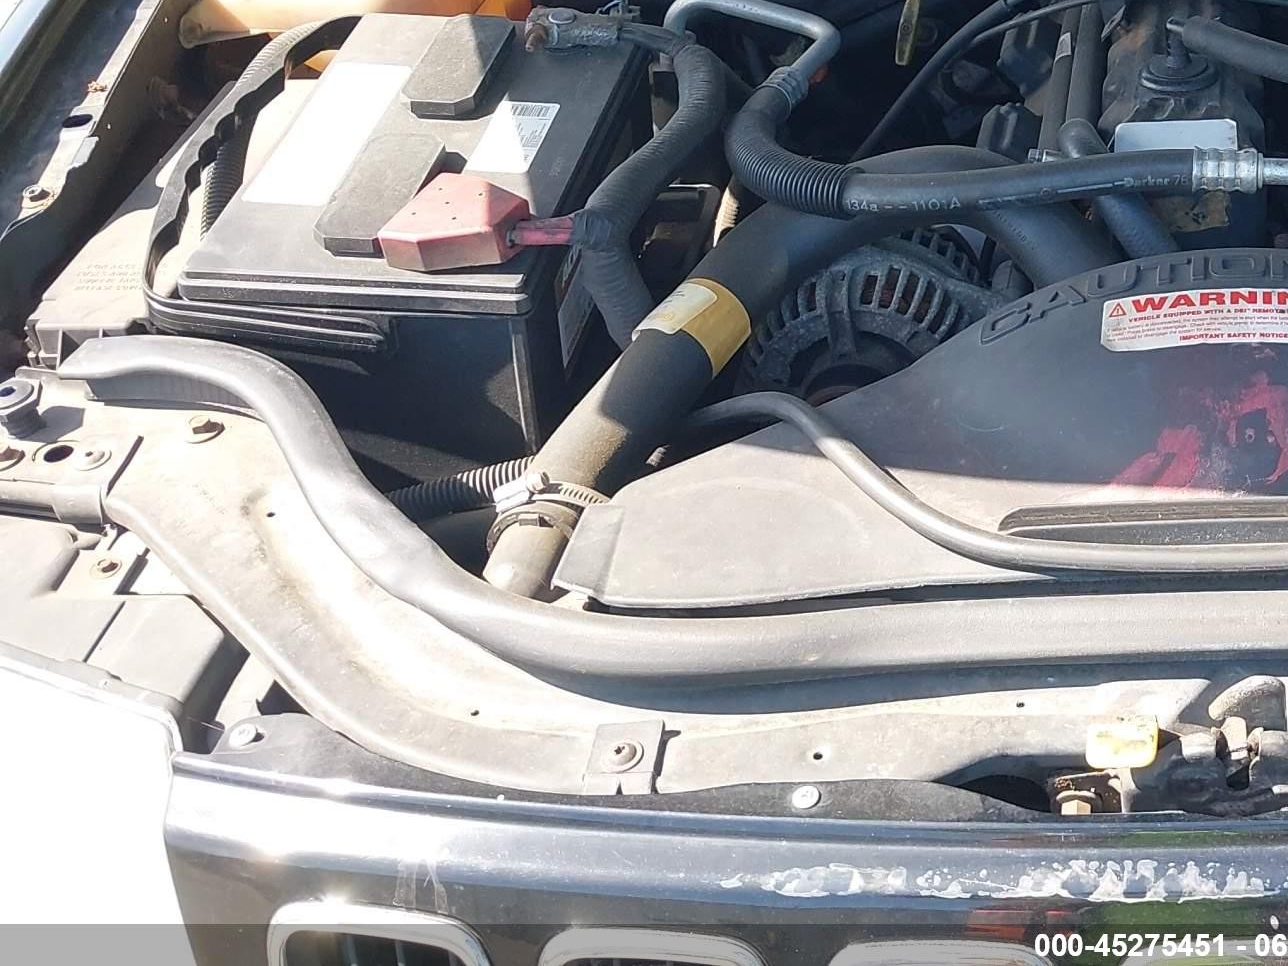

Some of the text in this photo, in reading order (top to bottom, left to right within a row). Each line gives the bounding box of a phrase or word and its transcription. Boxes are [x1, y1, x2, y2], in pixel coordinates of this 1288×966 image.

[846, 198, 880, 212] 134a
[1129, 314, 1161, 323] VEHICLE
[1163, 310, 1202, 319] EQUIPPED
[1179, 332, 1225, 342] IMPORTANT
